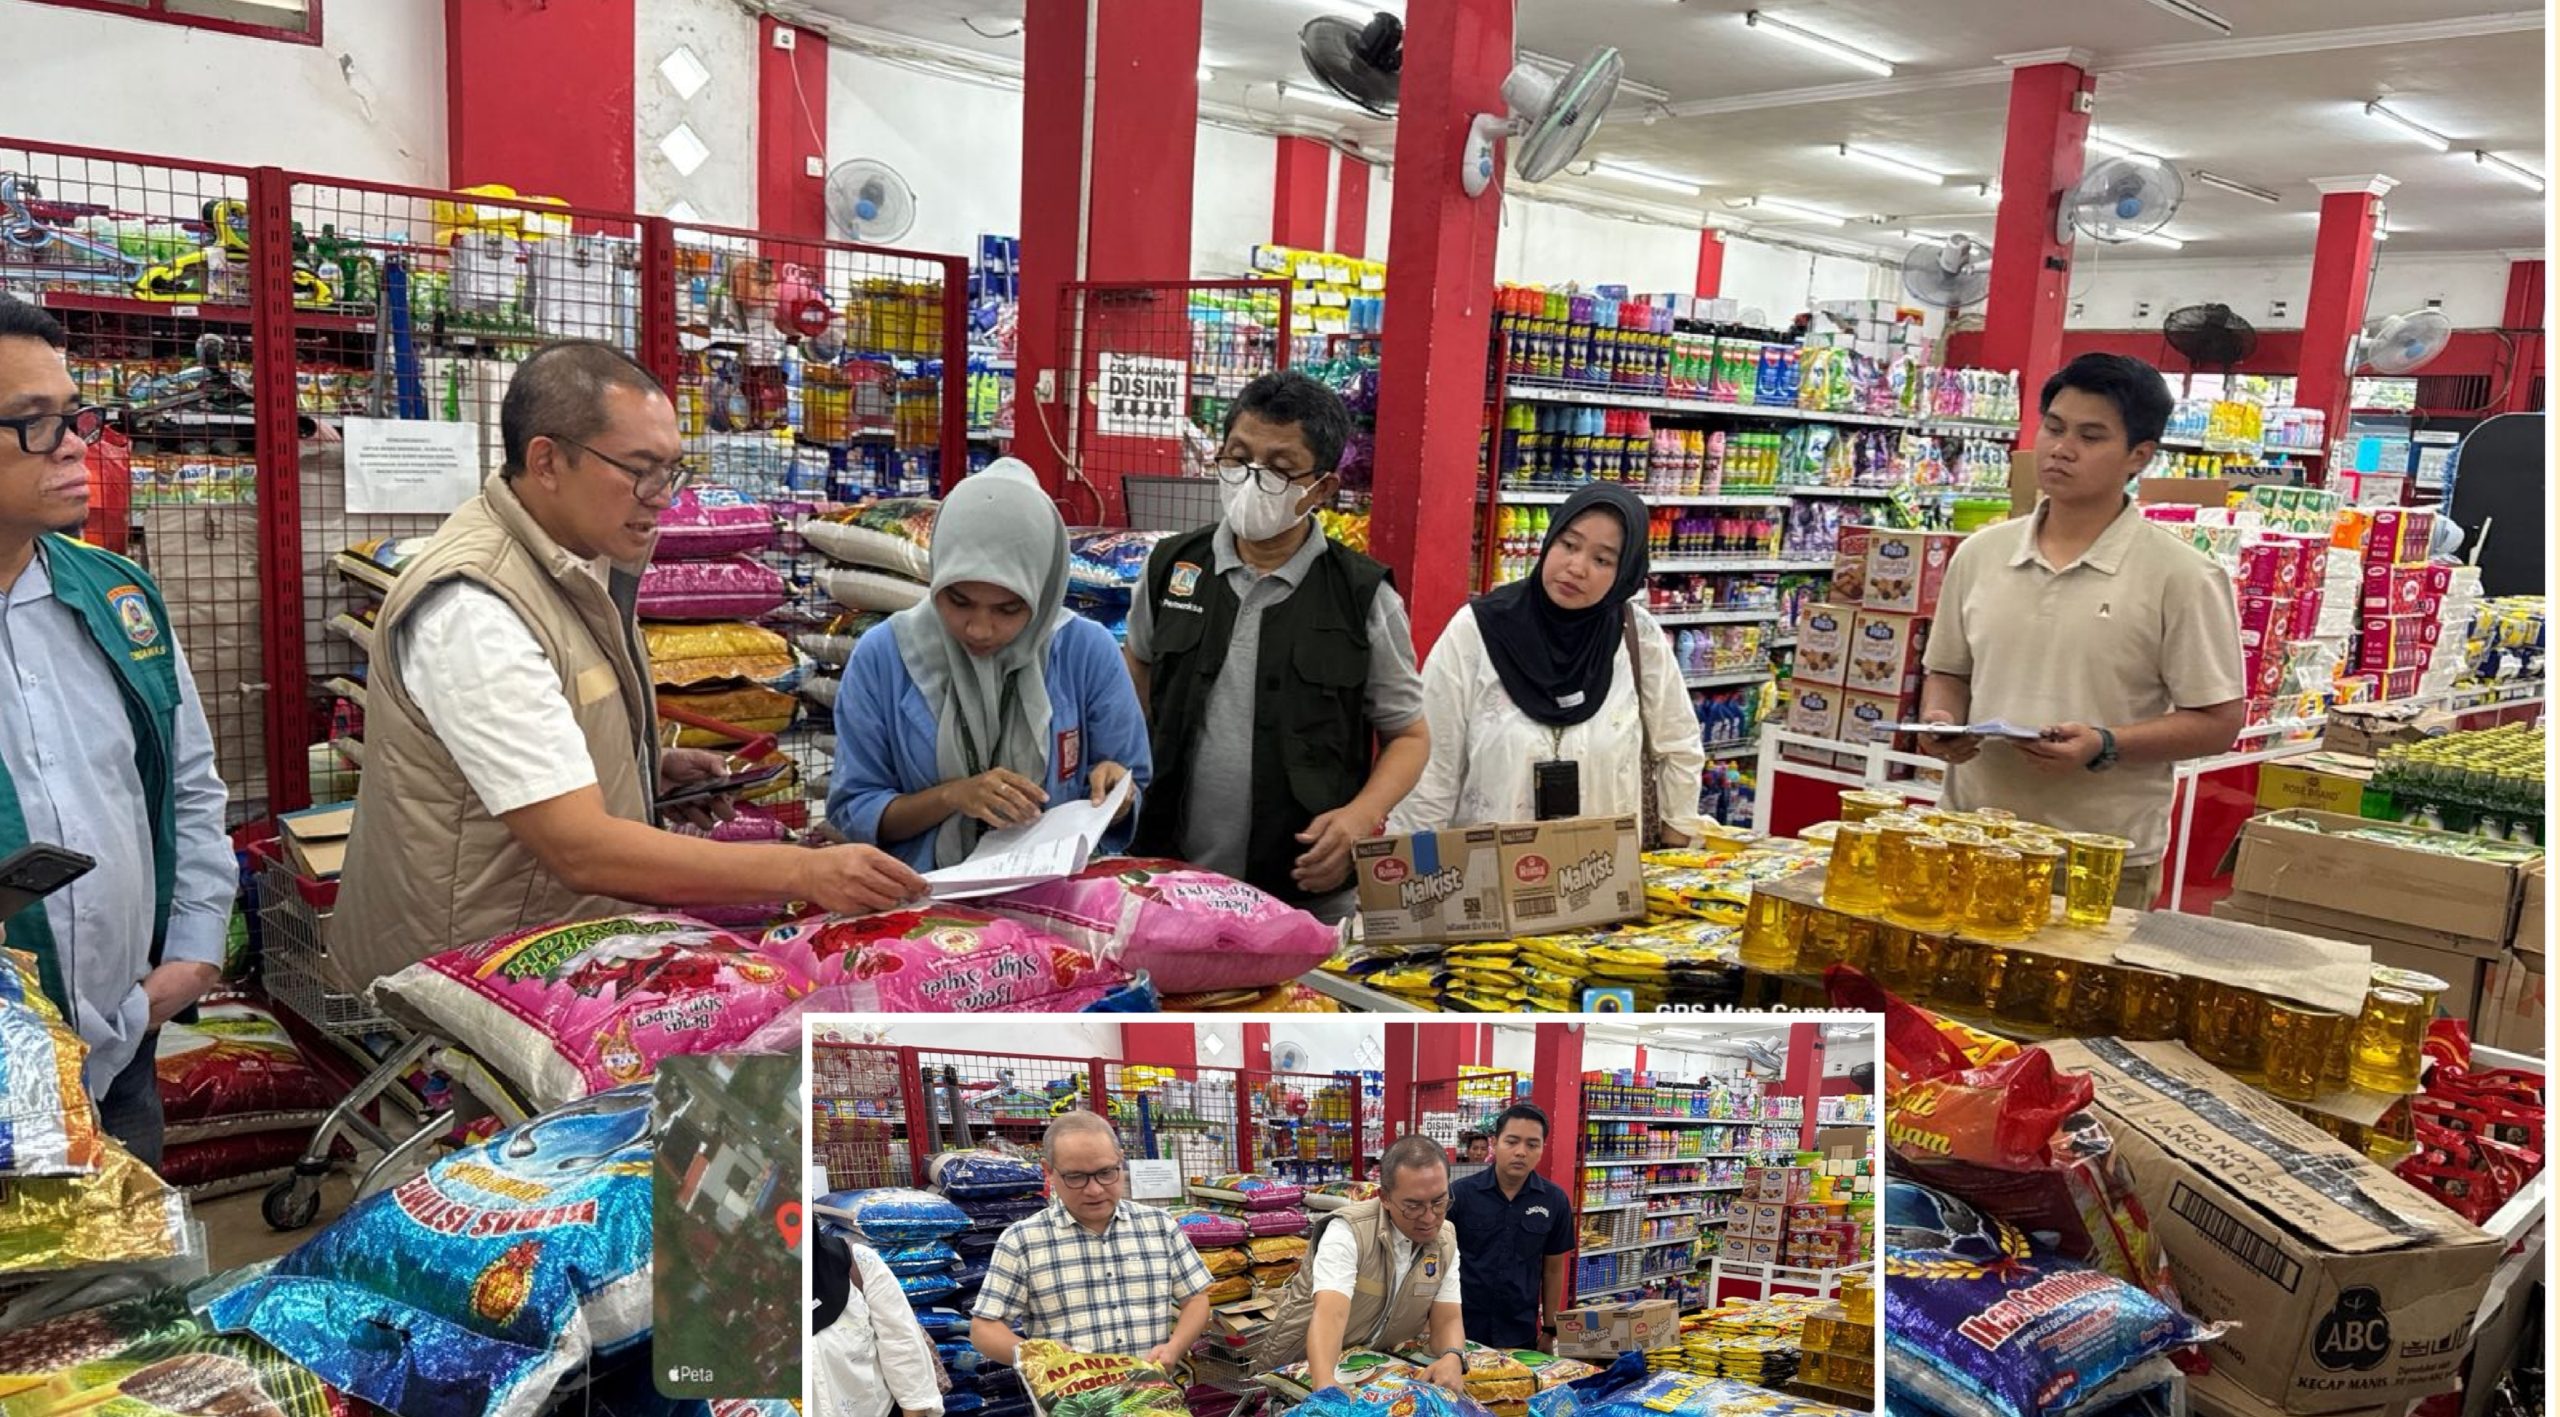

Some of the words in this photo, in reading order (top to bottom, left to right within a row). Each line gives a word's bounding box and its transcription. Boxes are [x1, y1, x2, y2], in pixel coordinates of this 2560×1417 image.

[1110, 376, 1176, 400] DISINI
[1400, 866, 1464, 909] Malkist
[1558, 850, 1614, 897] Malkist
[922, 968, 982, 999] Super
[954, 983, 1012, 1010] Beras
[664, 1013, 711, 1033] Beras
[1885, 1109, 1953, 1156] yam
[2145, 1117, 2234, 1171] JANGAN
[2179, 1123, 2212, 1143] DO
[2213, 1143, 2264, 1173] NOT
[1958, 1299, 2034, 1351] Ikan
[2321, 1319, 2386, 1353] ABC
[1046, 1356, 1134, 1383] NANAS
[2297, 1377, 2346, 1391] KECAP
[2349, 1377, 2388, 1390] MANIS
